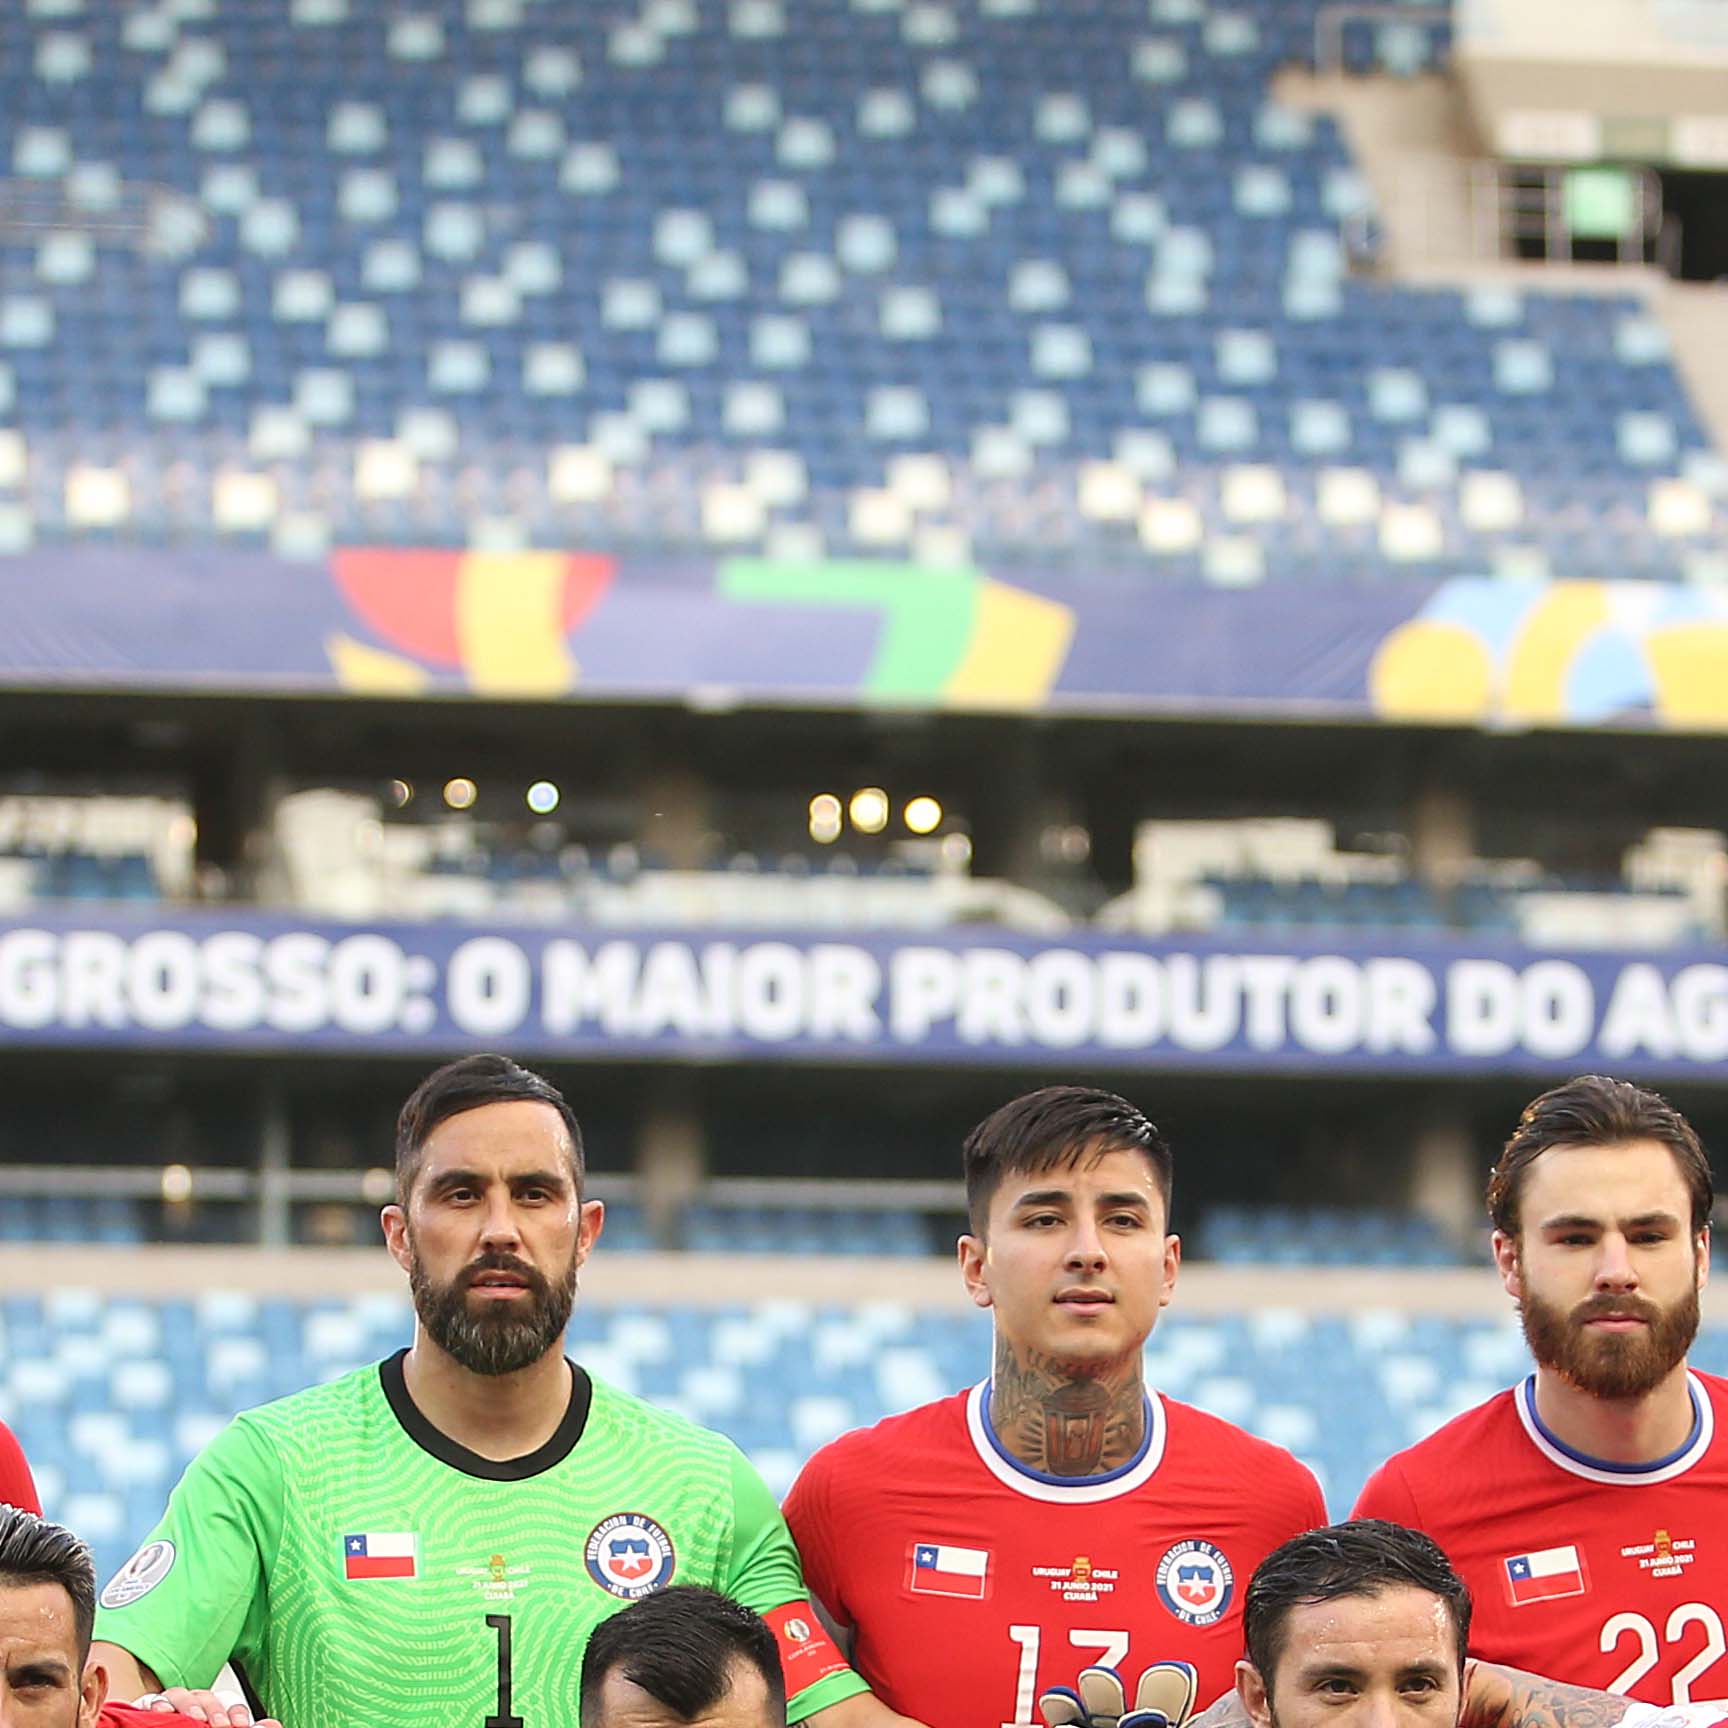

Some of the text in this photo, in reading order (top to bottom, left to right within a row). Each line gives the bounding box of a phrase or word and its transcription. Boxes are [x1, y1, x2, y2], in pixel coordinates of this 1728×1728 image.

[446, 935, 531, 1034] O
[540, 940, 881, 1042] MAIOR
[888, 945, 1437, 1056] PRODUTOR
[1448, 960, 1593, 1058] DO
